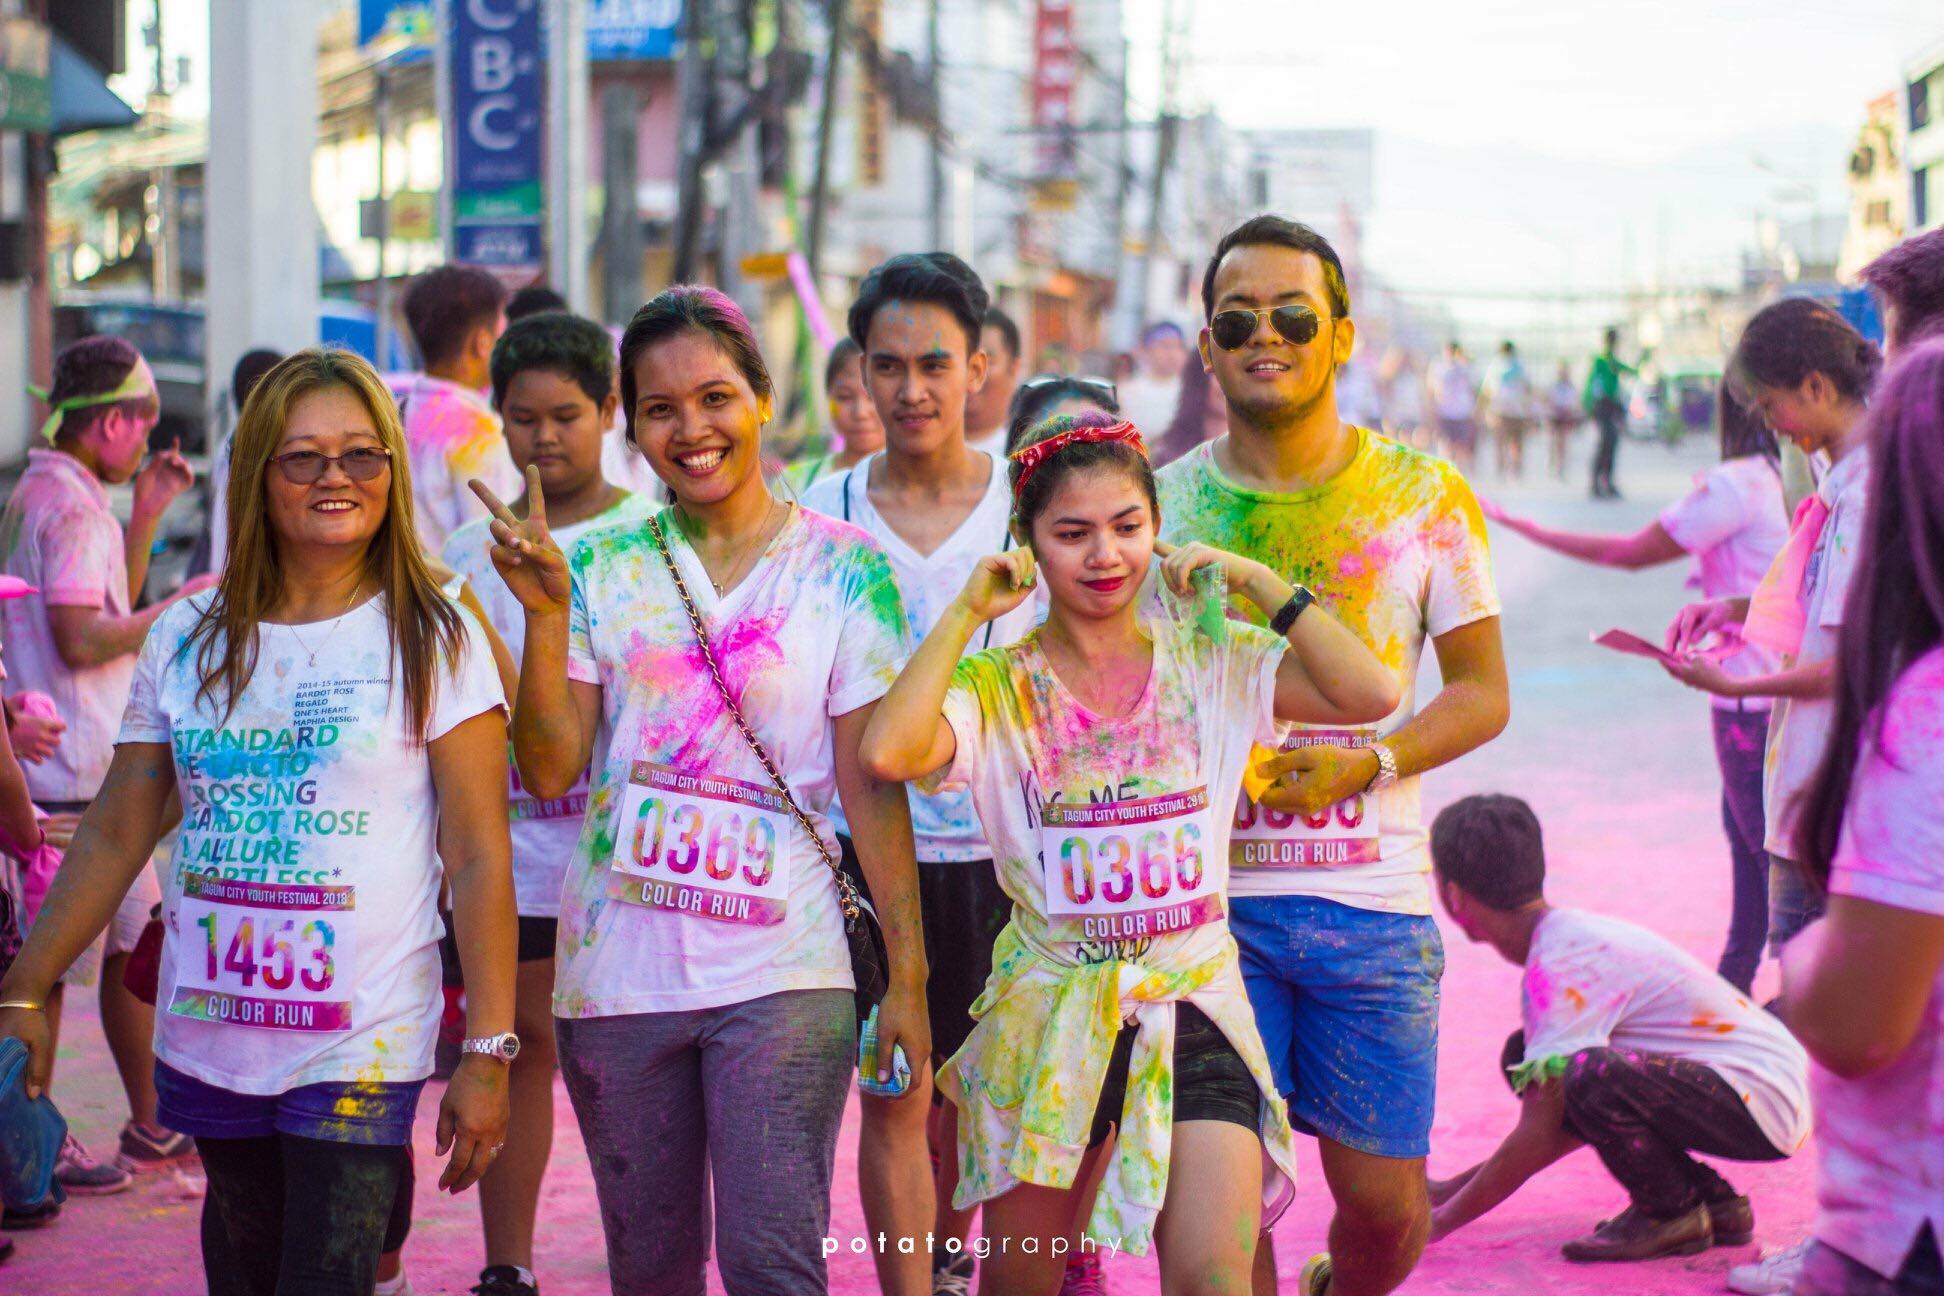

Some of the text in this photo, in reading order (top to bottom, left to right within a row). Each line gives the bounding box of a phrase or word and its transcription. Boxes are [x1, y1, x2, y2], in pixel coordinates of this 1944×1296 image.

[297, 681, 331, 689] 2014-15
[333, 687, 355, 695] ROSE
[294, 706, 349, 717] ONE'S HEART
[295, 699, 328, 708] REGALO
[293, 715, 360, 727] MAPHIA DESIGN
[174, 724, 340, 754] STANDARD
[1285, 736, 1311, 749] YOUTH
[188, 779, 318, 807] ROSSING
[651, 769, 783, 808] TAGUM CITY YOUTH FESTIVAL 2018
[293, 810, 371, 836] ROSE
[1063, 809, 1093, 822] TAGUM
[1094, 808, 1117, 822] CITY
[1117, 806, 1147, 820] YOUTH
[1148, 801, 1186, 817] FESTIVAL
[632, 797, 776, 887] 0369
[1245, 841, 1348, 863] COLOR RUN
[1060, 822, 1203, 905] 0366
[201, 881, 225, 898] TAGUM
[226, 886, 246, 900] CITY
[246, 889, 275, 903] YOUTH
[278, 891, 320, 905] FESTIVAL
[641, 882, 750, 919] COLOR RUN
[1084, 905, 1191, 938] COLOR RUN
[197, 911, 335, 992] 1453
[207, 995, 314, 1026] COLOR RUN
